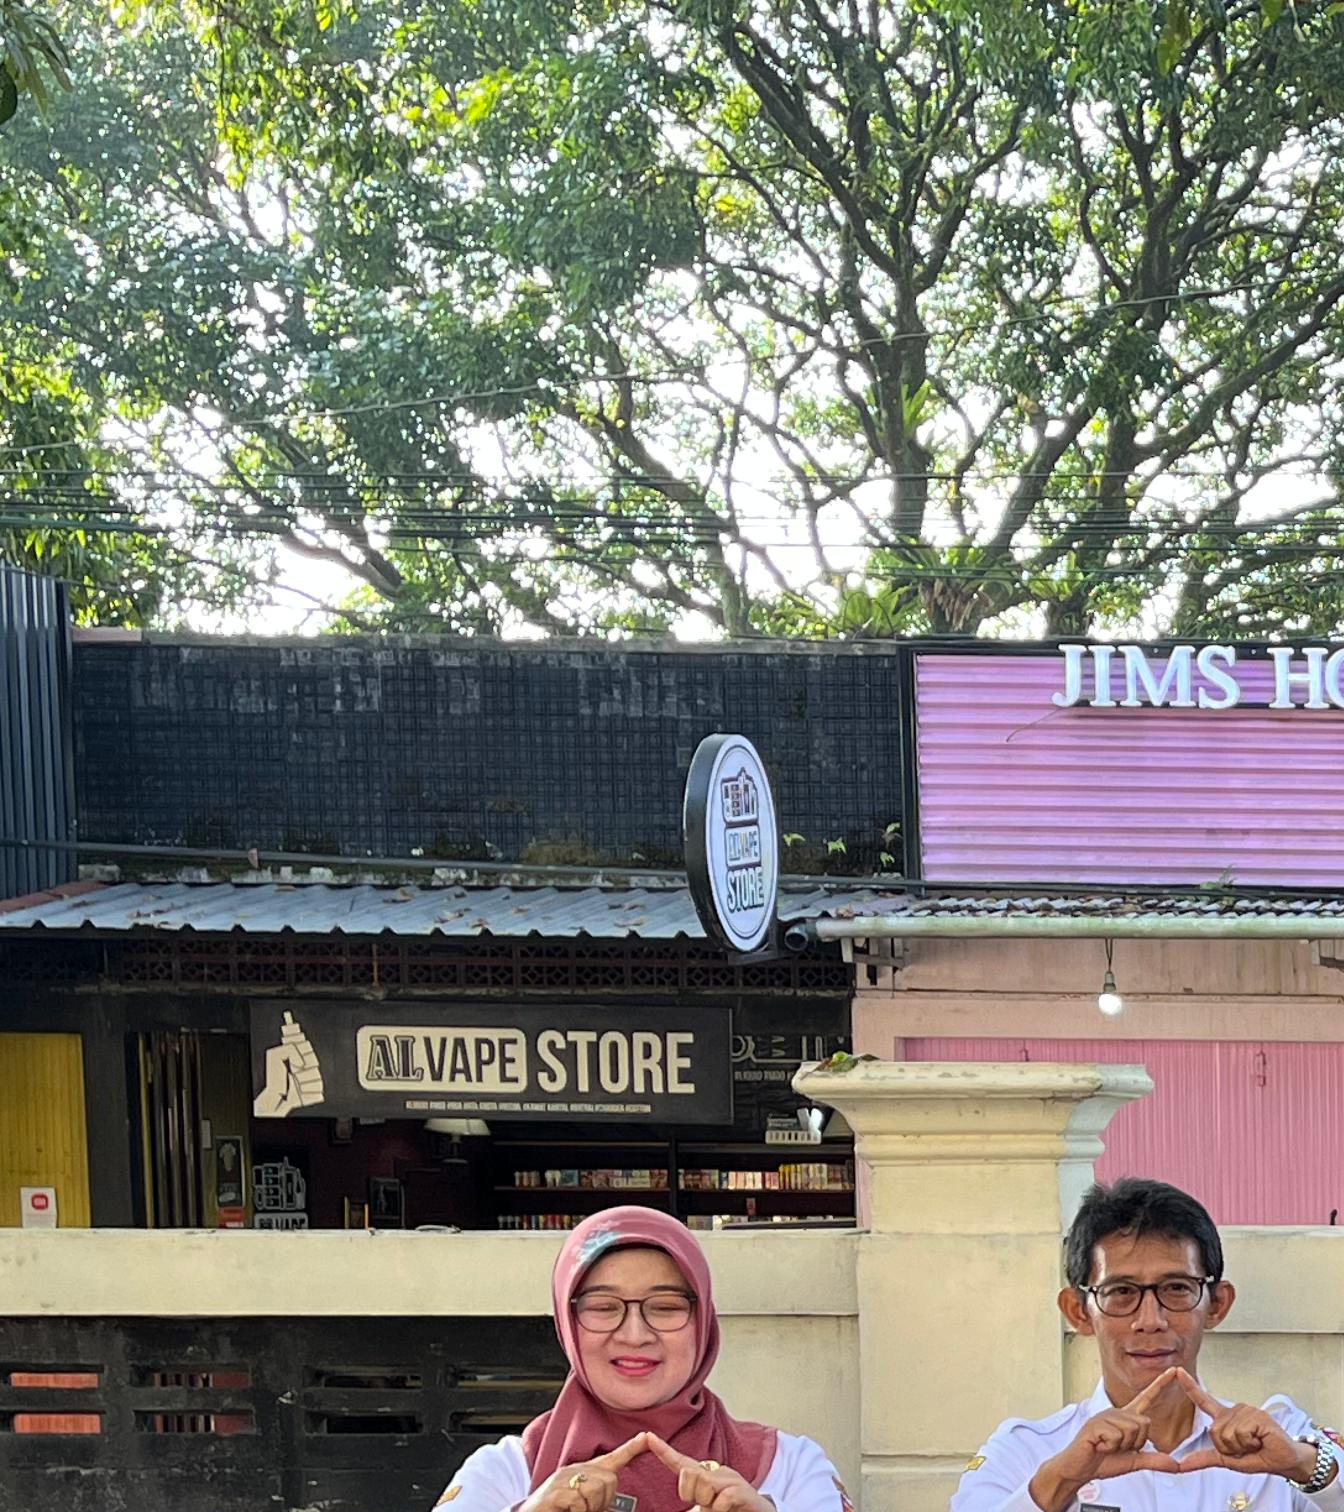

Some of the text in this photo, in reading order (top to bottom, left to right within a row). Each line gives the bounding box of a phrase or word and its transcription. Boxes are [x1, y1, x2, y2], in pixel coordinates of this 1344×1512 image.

[1051, 643, 1238, 710] JIMS
[727, 867, 764, 912] STORE
[537, 1029, 697, 1094] STORE
